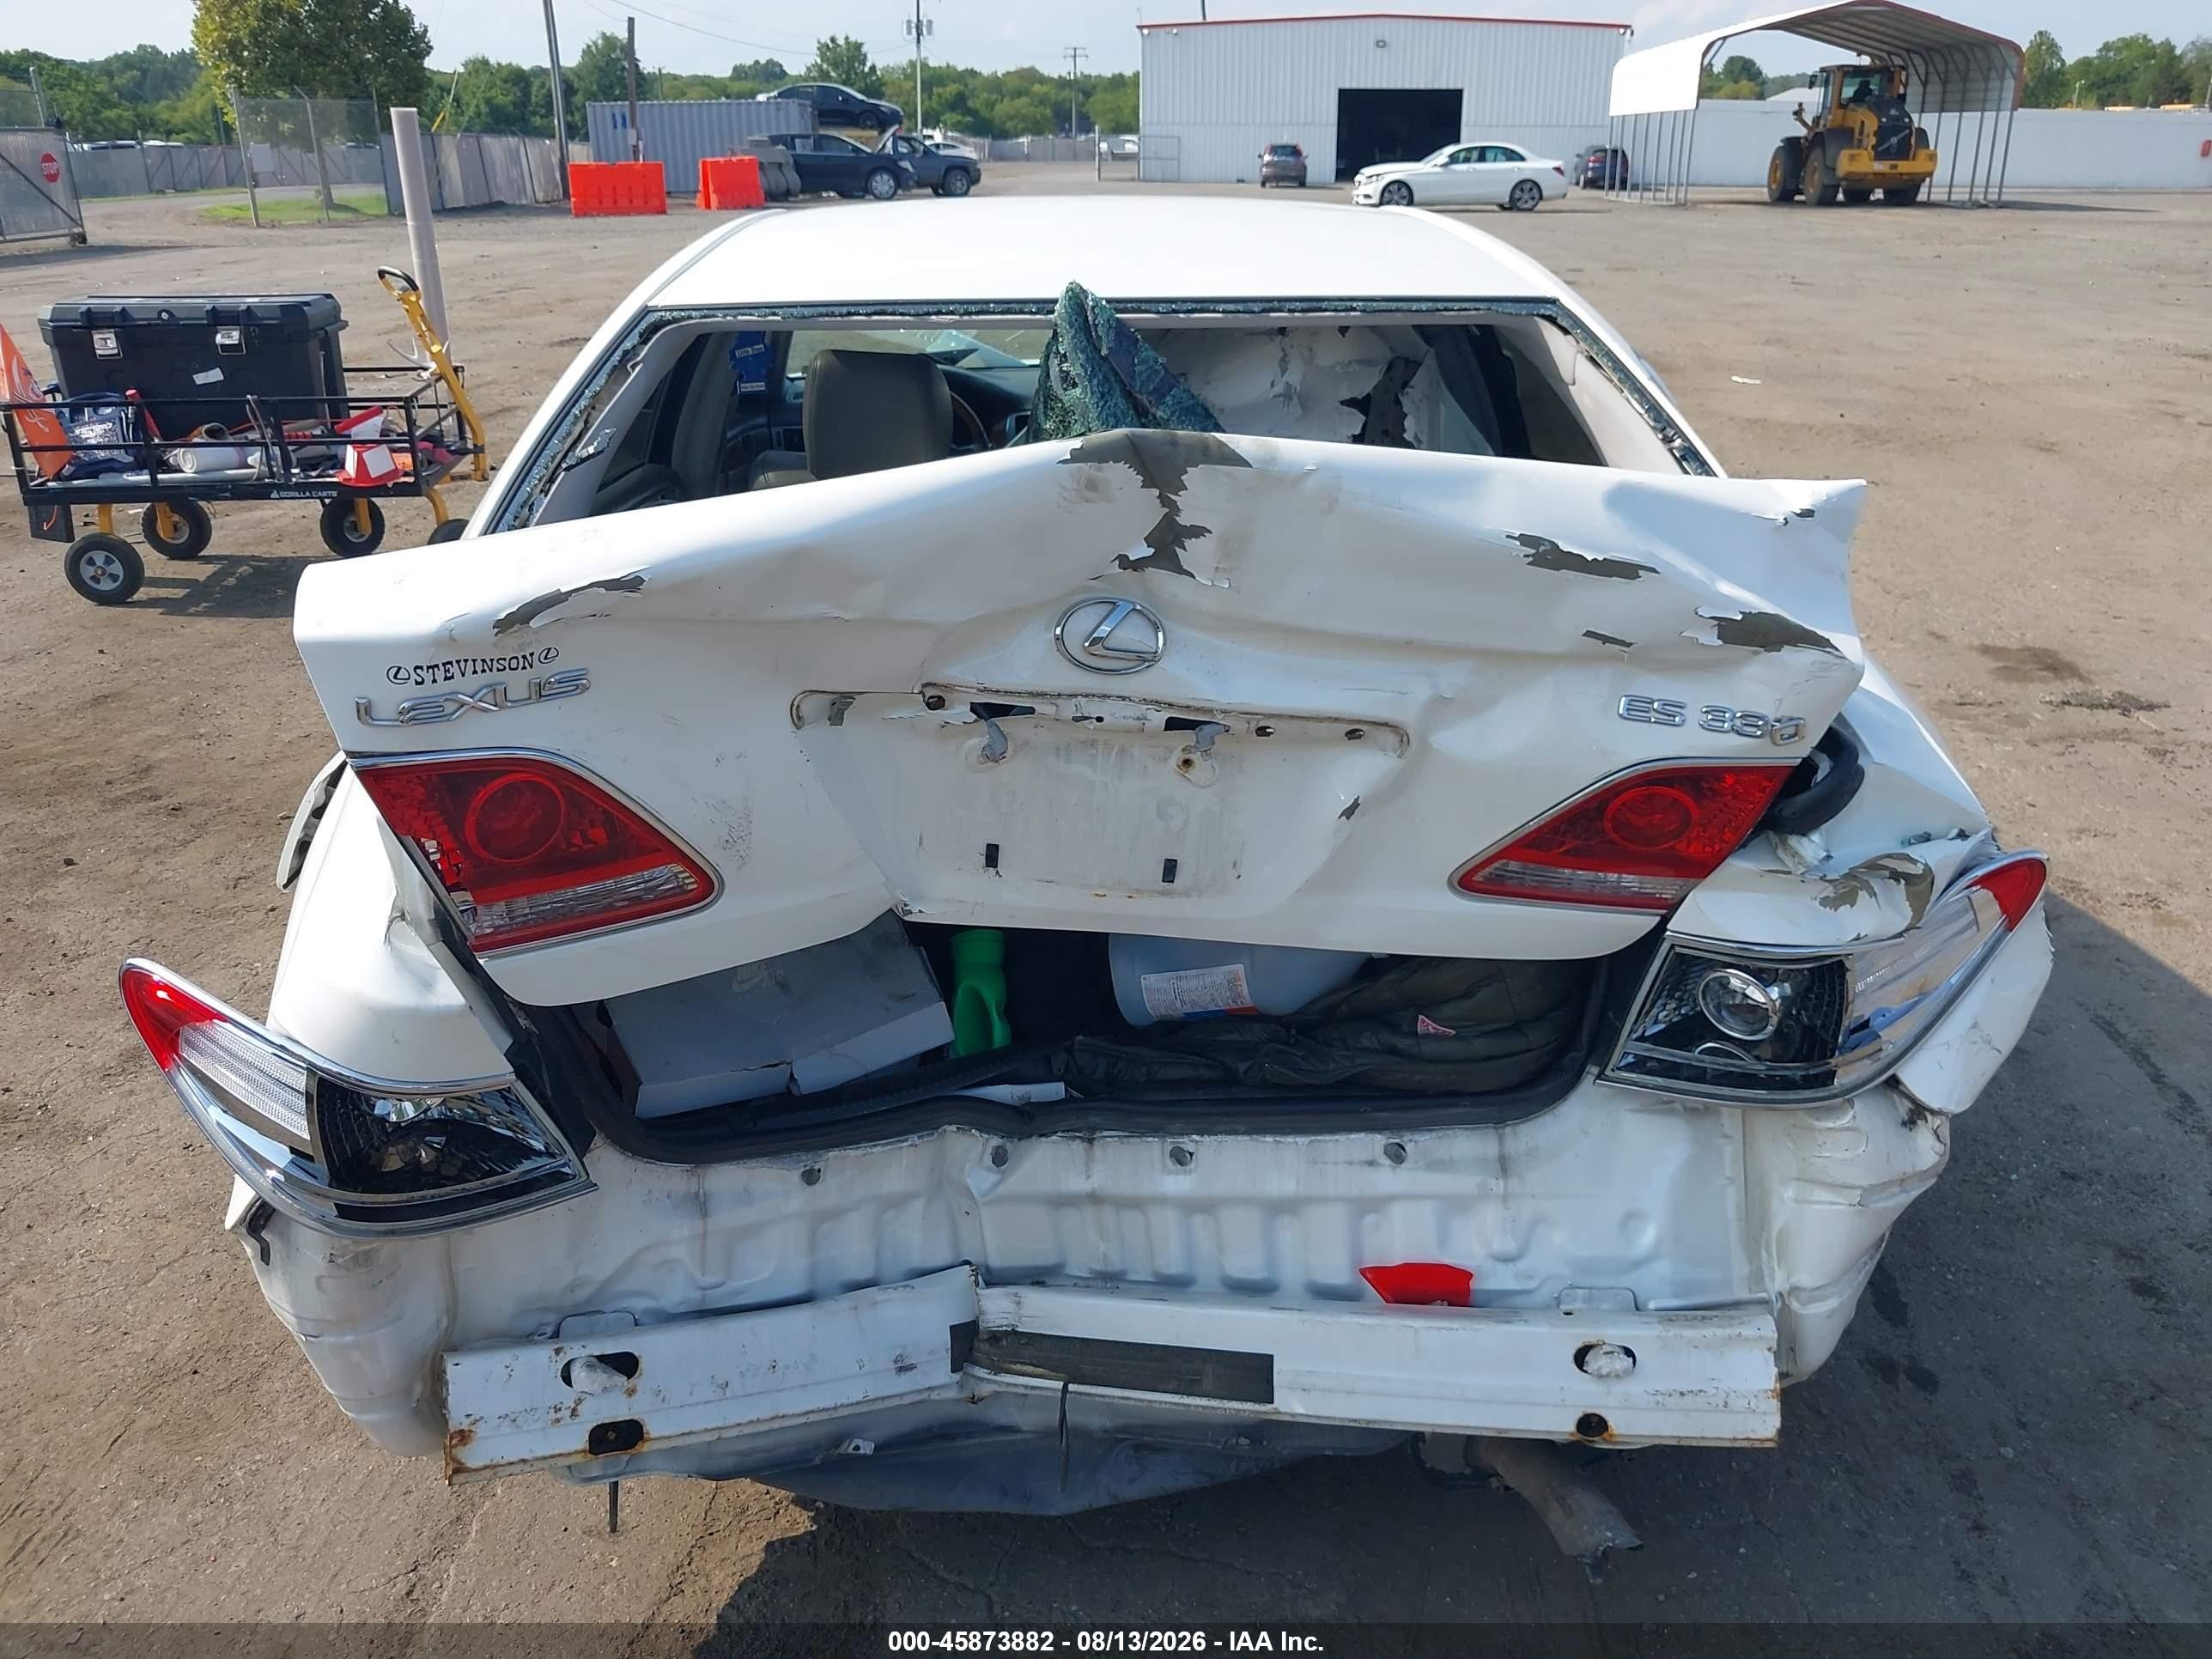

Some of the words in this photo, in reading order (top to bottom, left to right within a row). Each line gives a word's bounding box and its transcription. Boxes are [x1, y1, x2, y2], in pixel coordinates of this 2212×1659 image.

[41, 162, 59, 175] STOP
[413, 651, 535, 686] STEVINSON
[355, 667, 592, 727] LEXUS
[1618, 694, 1686, 727] ES
[1698, 704, 1807, 747] 330
